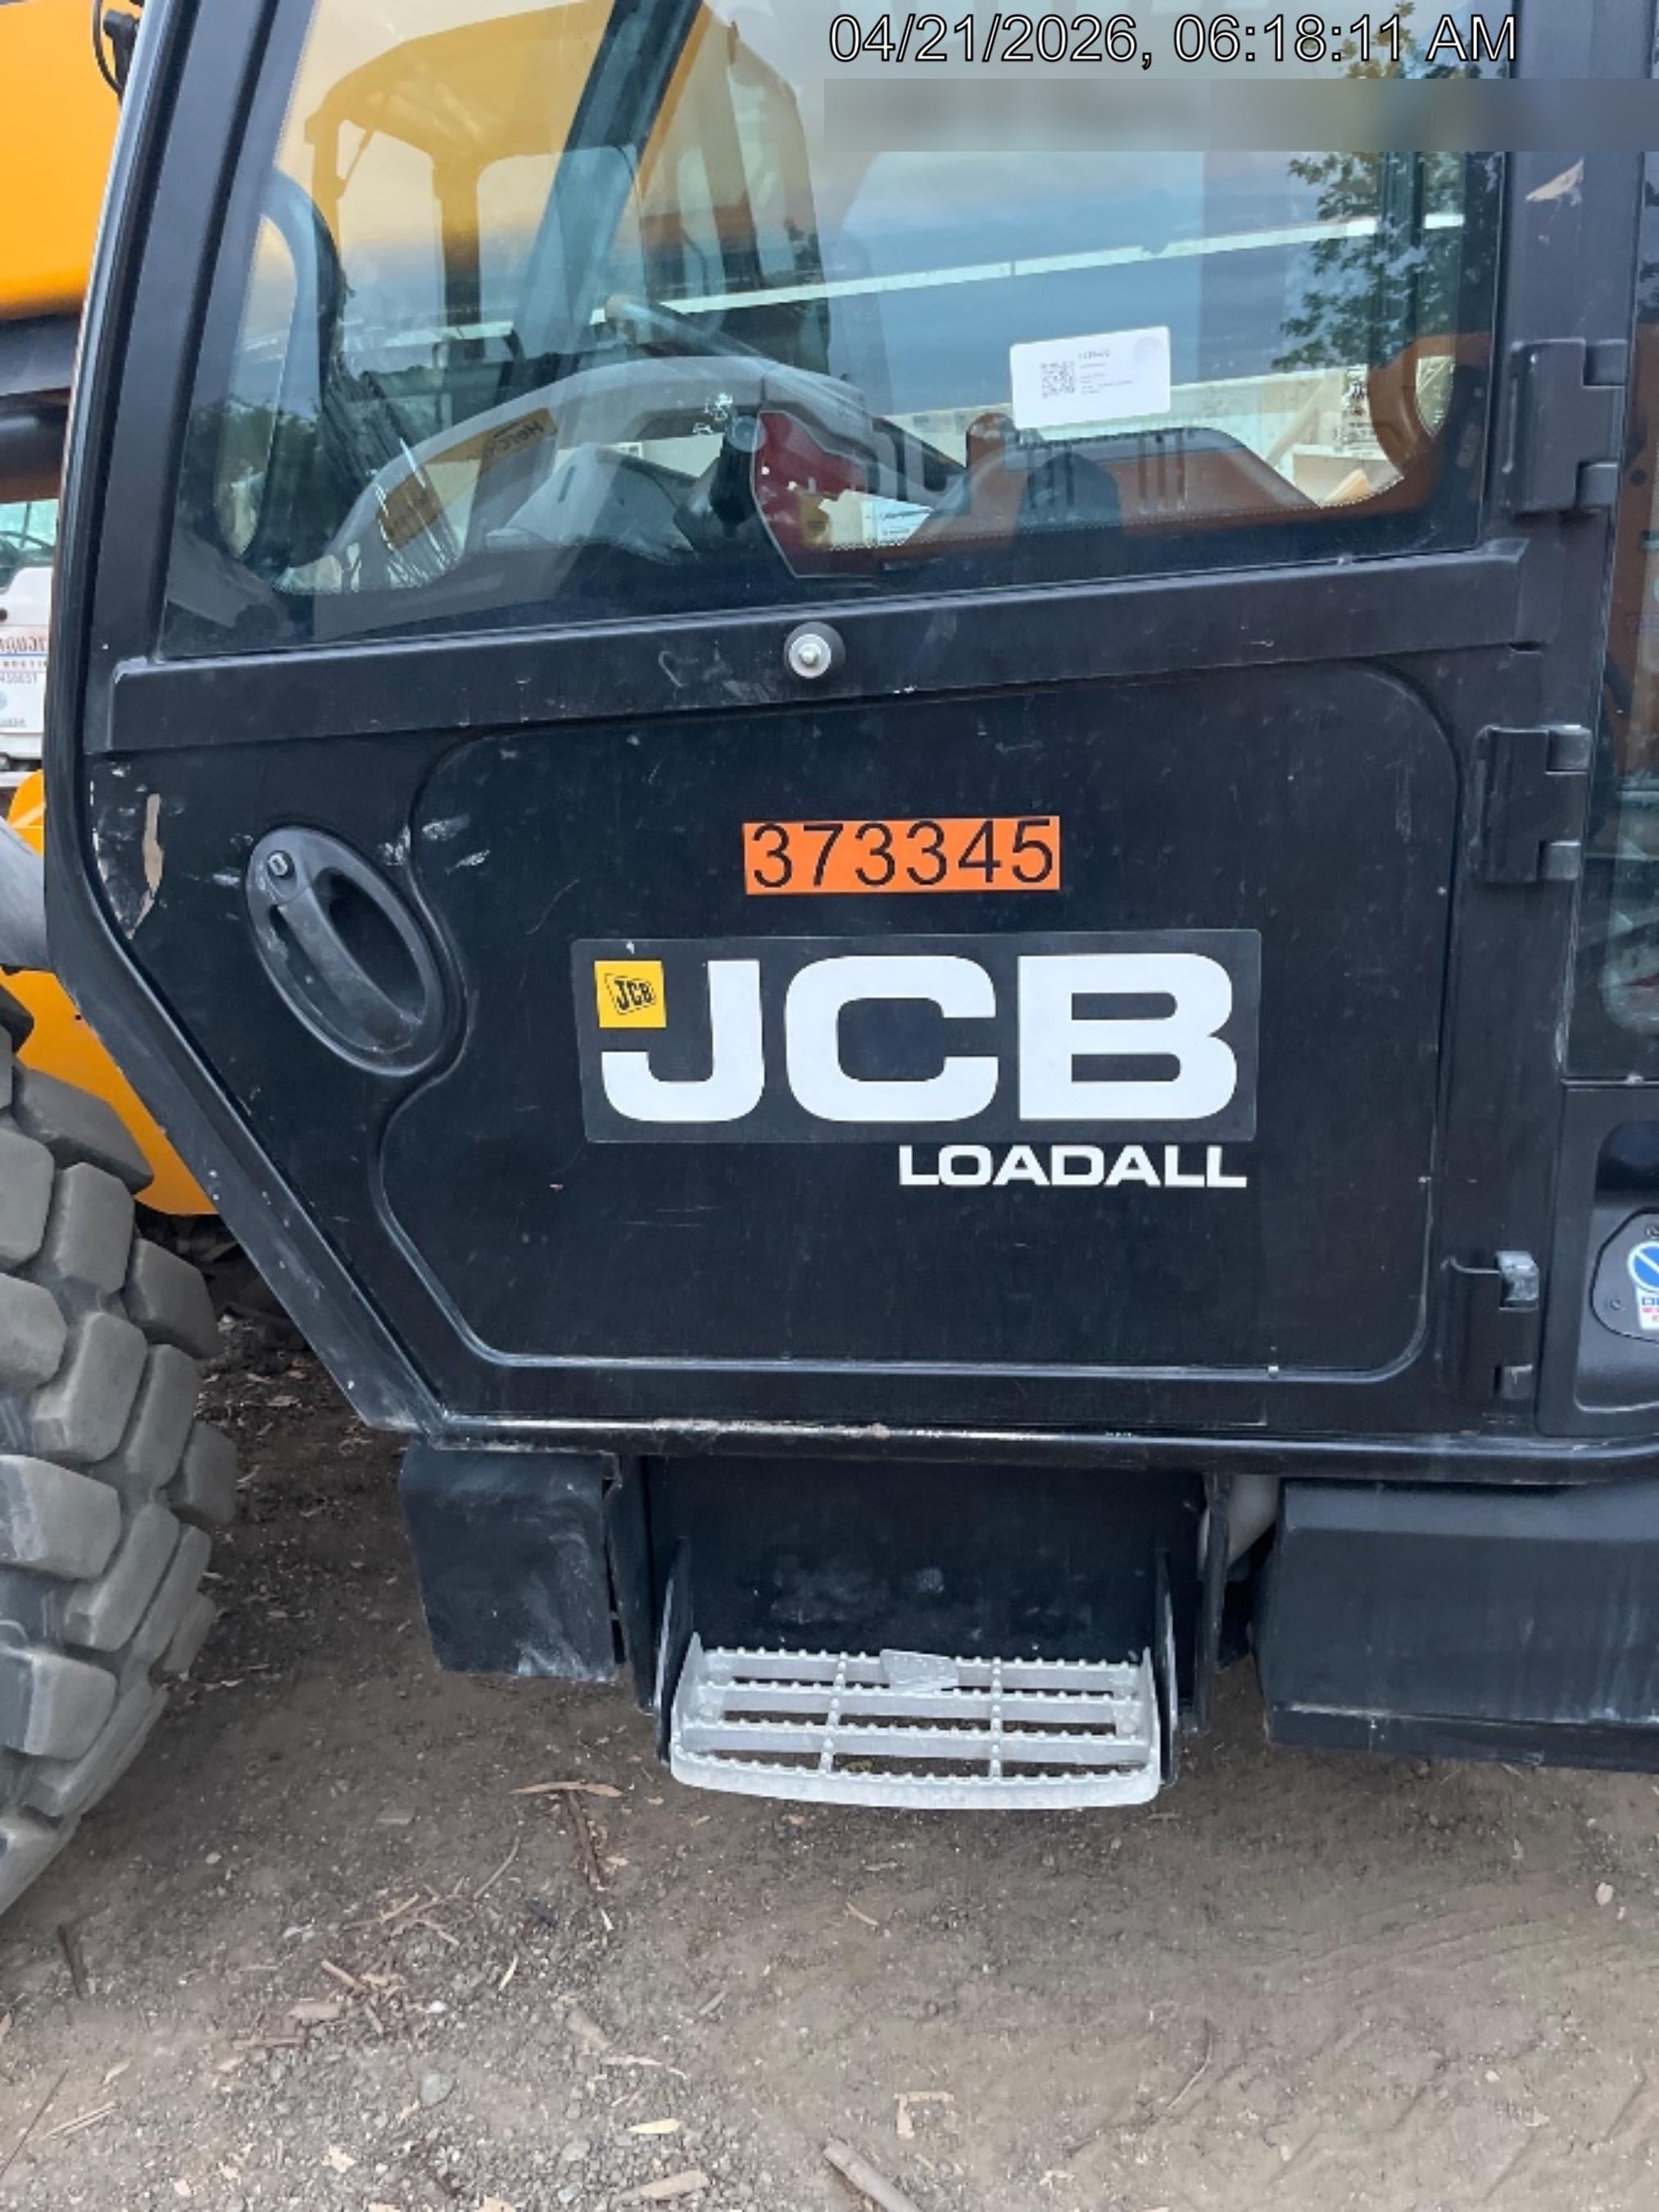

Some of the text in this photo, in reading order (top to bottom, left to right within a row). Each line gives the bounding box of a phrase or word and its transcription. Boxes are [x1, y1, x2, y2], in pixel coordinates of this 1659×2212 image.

[752, 818, 1054, 888] 373345
[614, 980, 652, 1010] JCB
[602, 954, 1237, 1122] JCB
[899, 1145, 1248, 1188] LOADALL
